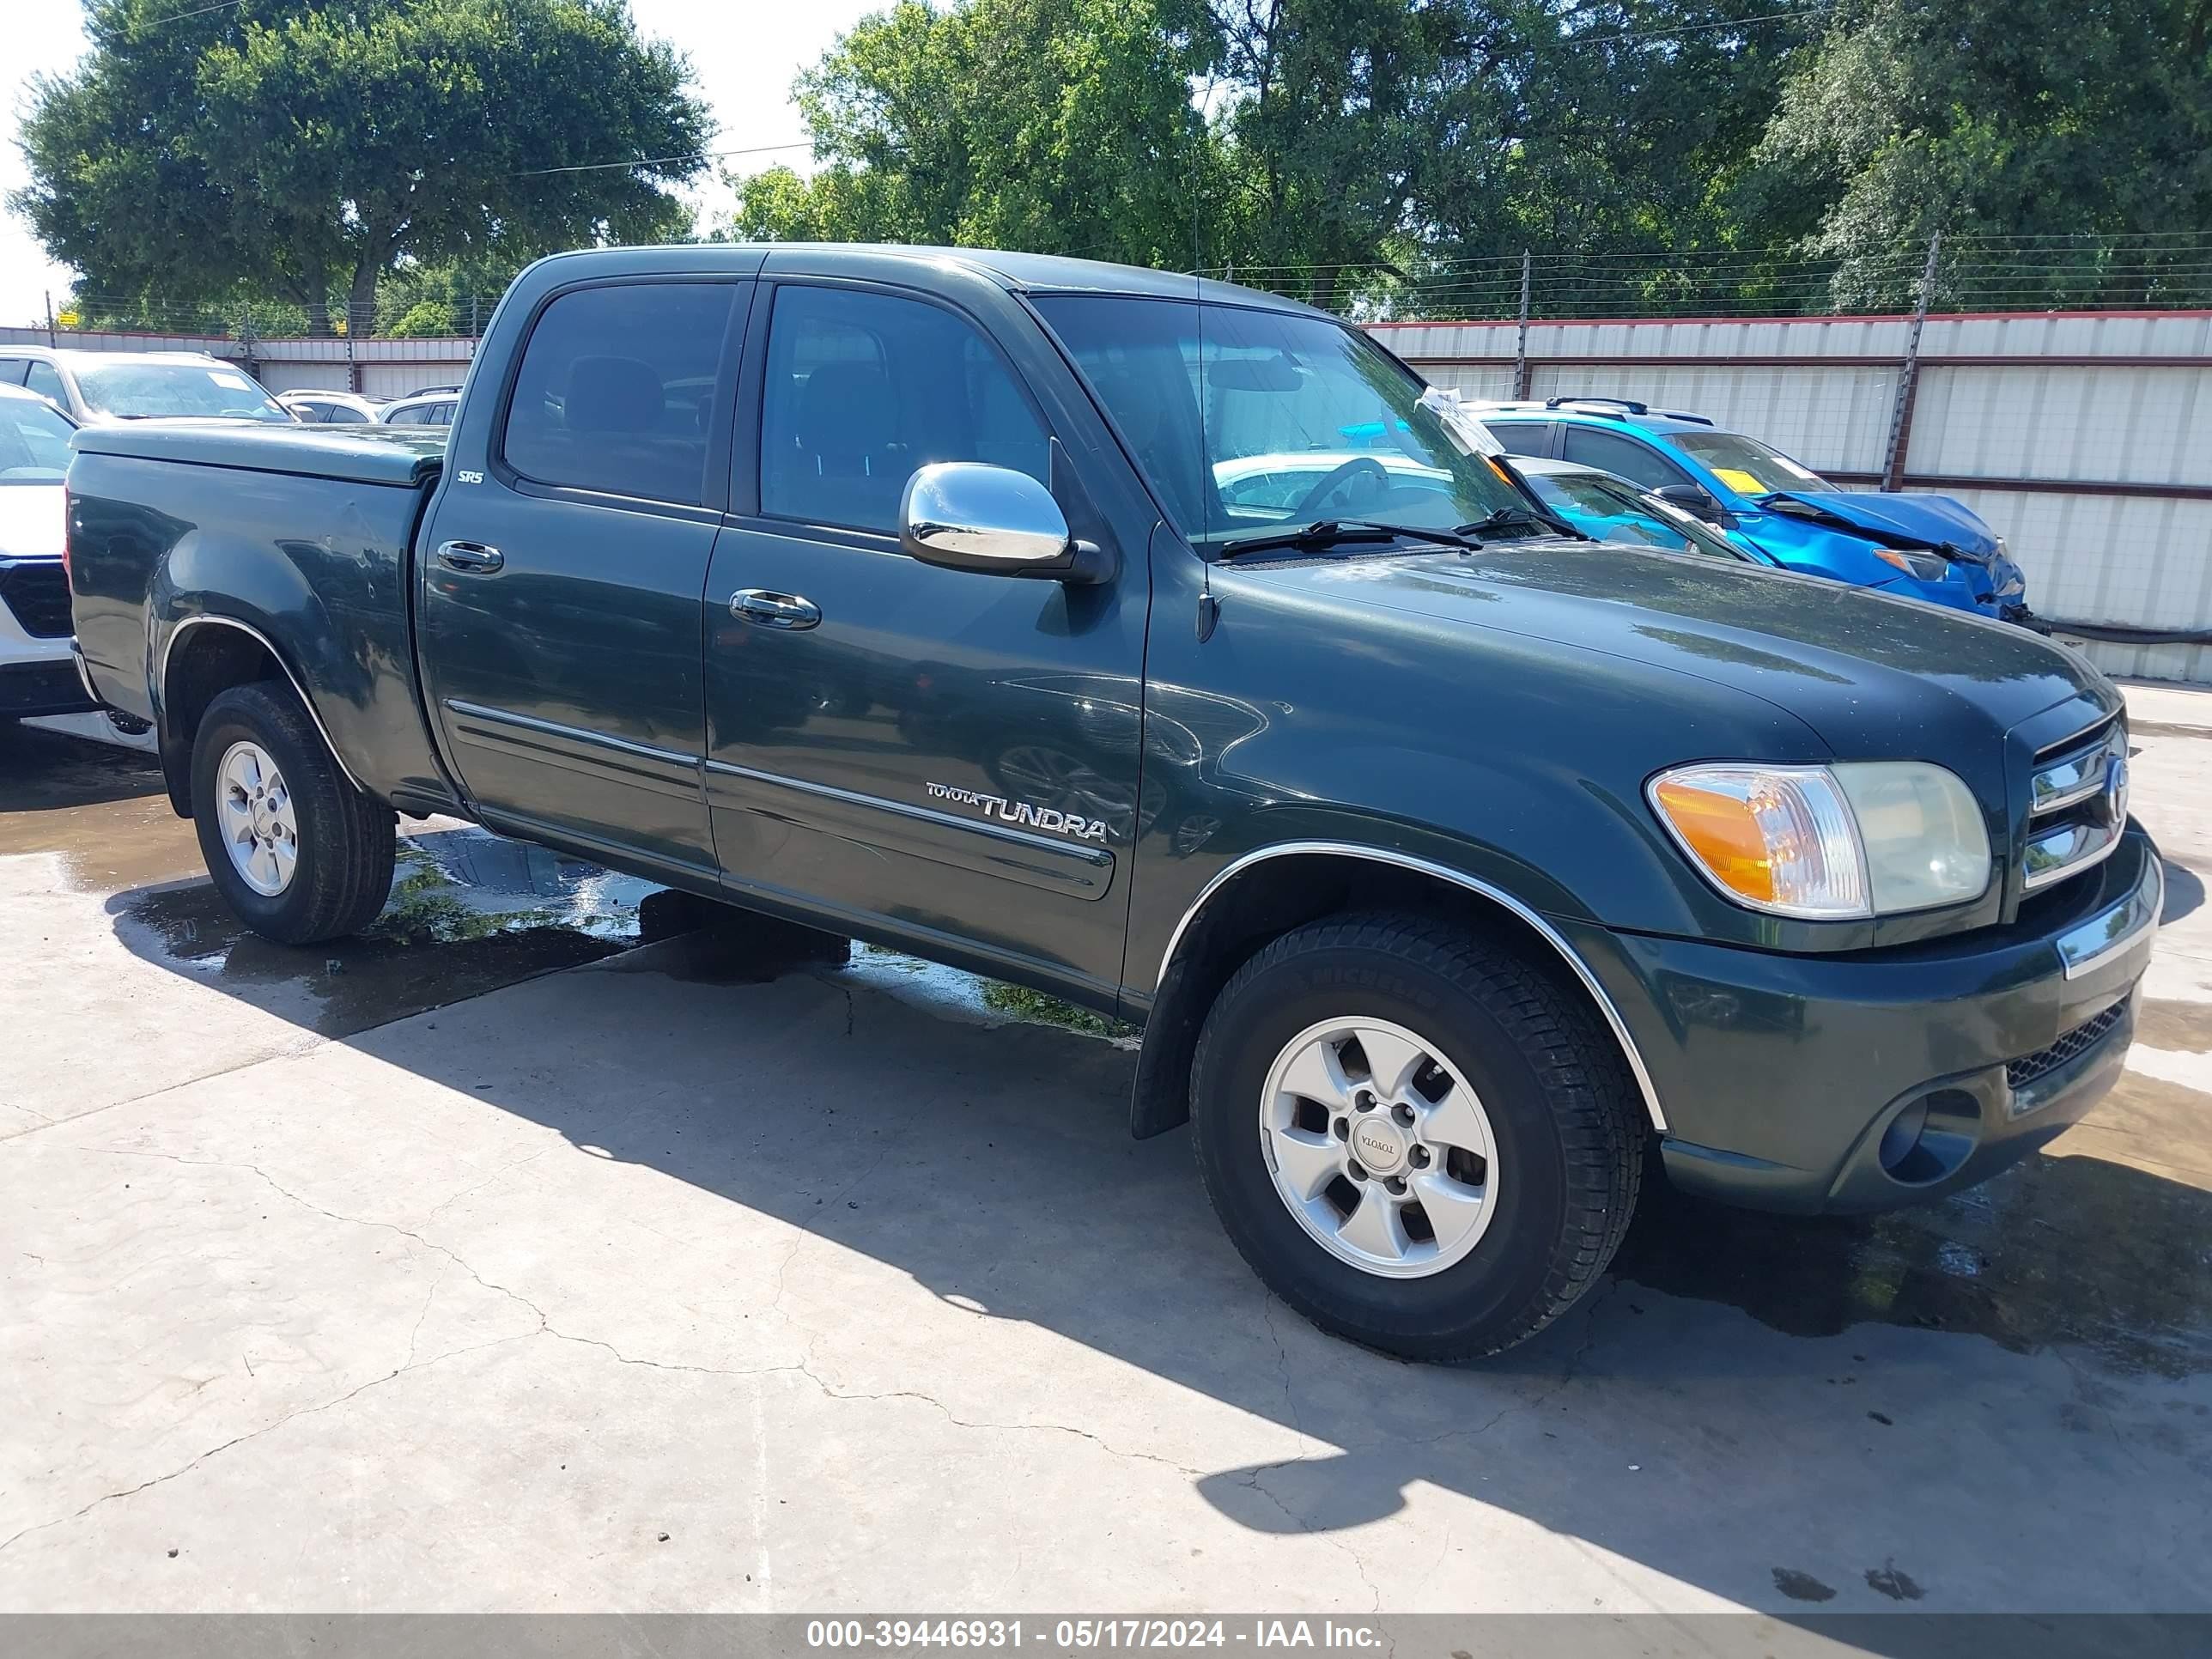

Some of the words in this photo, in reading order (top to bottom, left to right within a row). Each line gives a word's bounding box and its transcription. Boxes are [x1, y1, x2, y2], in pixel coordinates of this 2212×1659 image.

[457, 470, 484, 484] SR5
[925, 781, 981, 806] TOYOTA
[977, 793, 1108, 844] TUNDRA
[1361, 1135, 1395, 1155] TOYOTA
